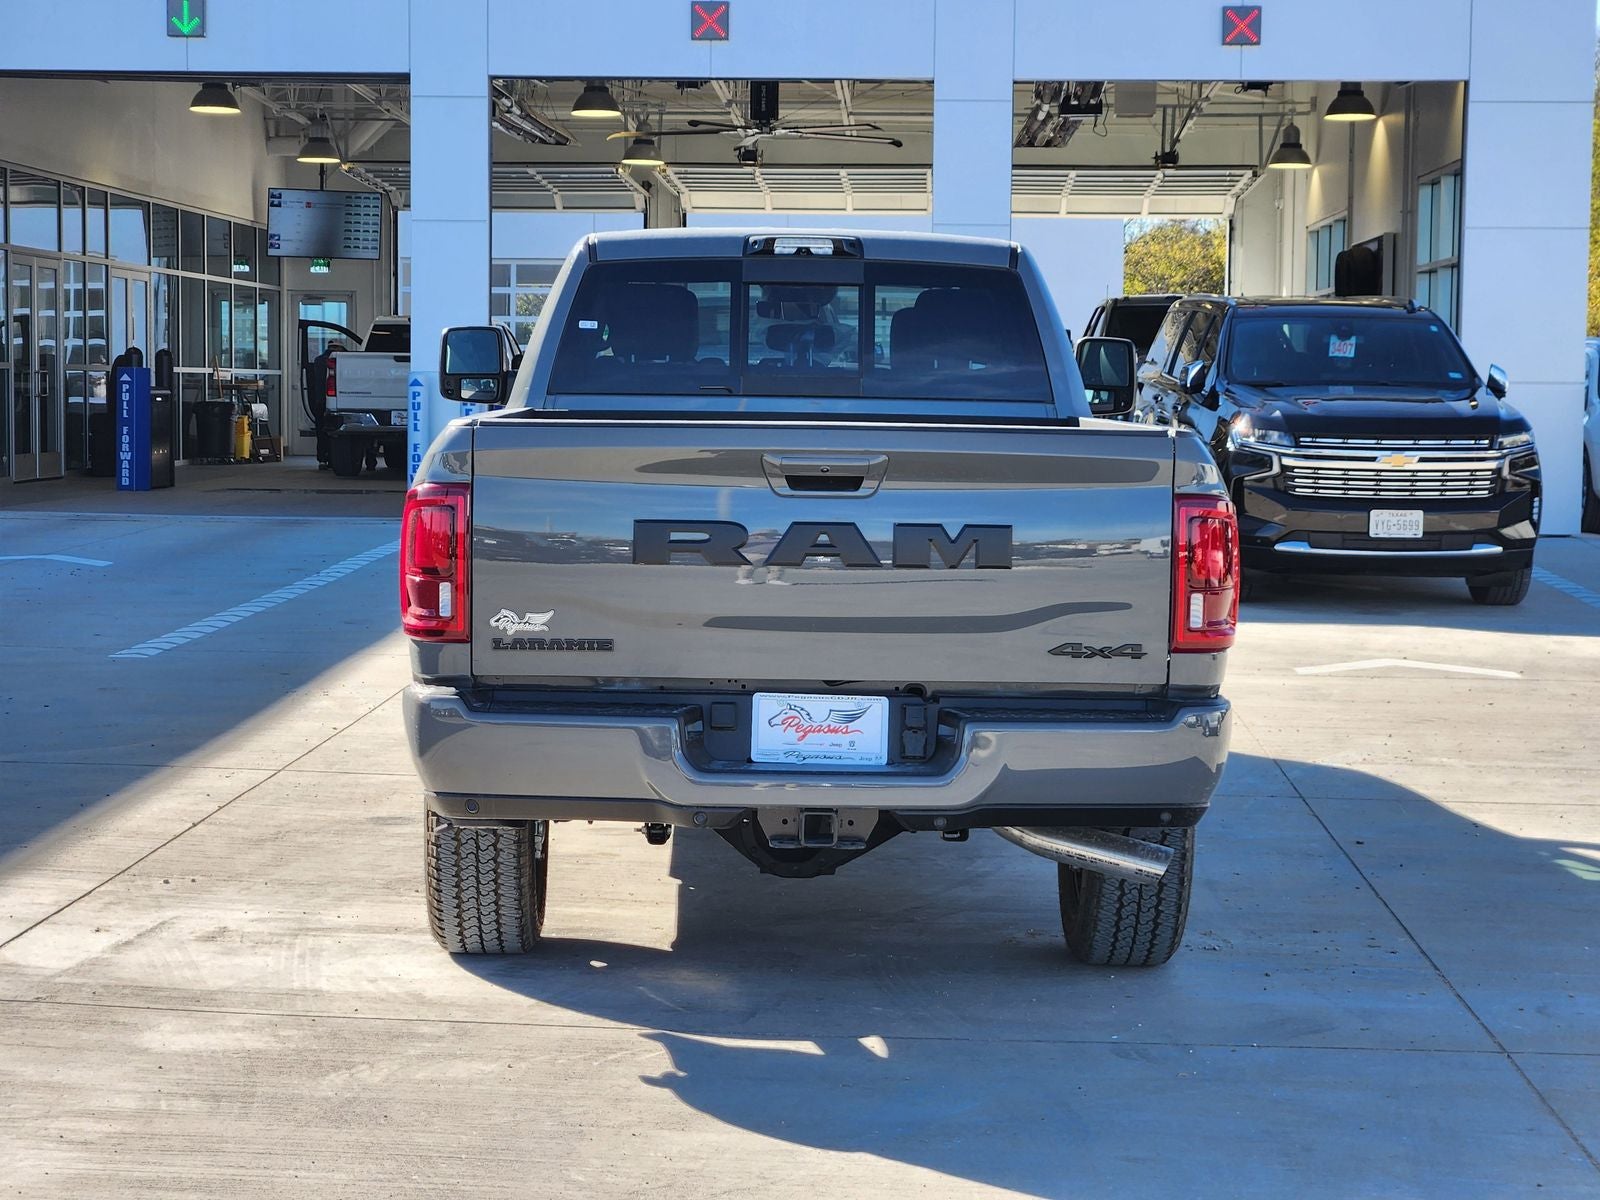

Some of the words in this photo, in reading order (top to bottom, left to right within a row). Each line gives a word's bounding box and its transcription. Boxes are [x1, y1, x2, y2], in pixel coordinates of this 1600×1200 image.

[1331, 341, 1354, 355] 3407
[411, 391, 421, 432] PULL
[120, 426, 131, 486] FORWARD
[633, 519, 1013, 570] RAM
[492, 638, 614, 651] LARAMIE
[1047, 642, 1148, 660] 4x4
[781, 715, 864, 742] Pegasus
